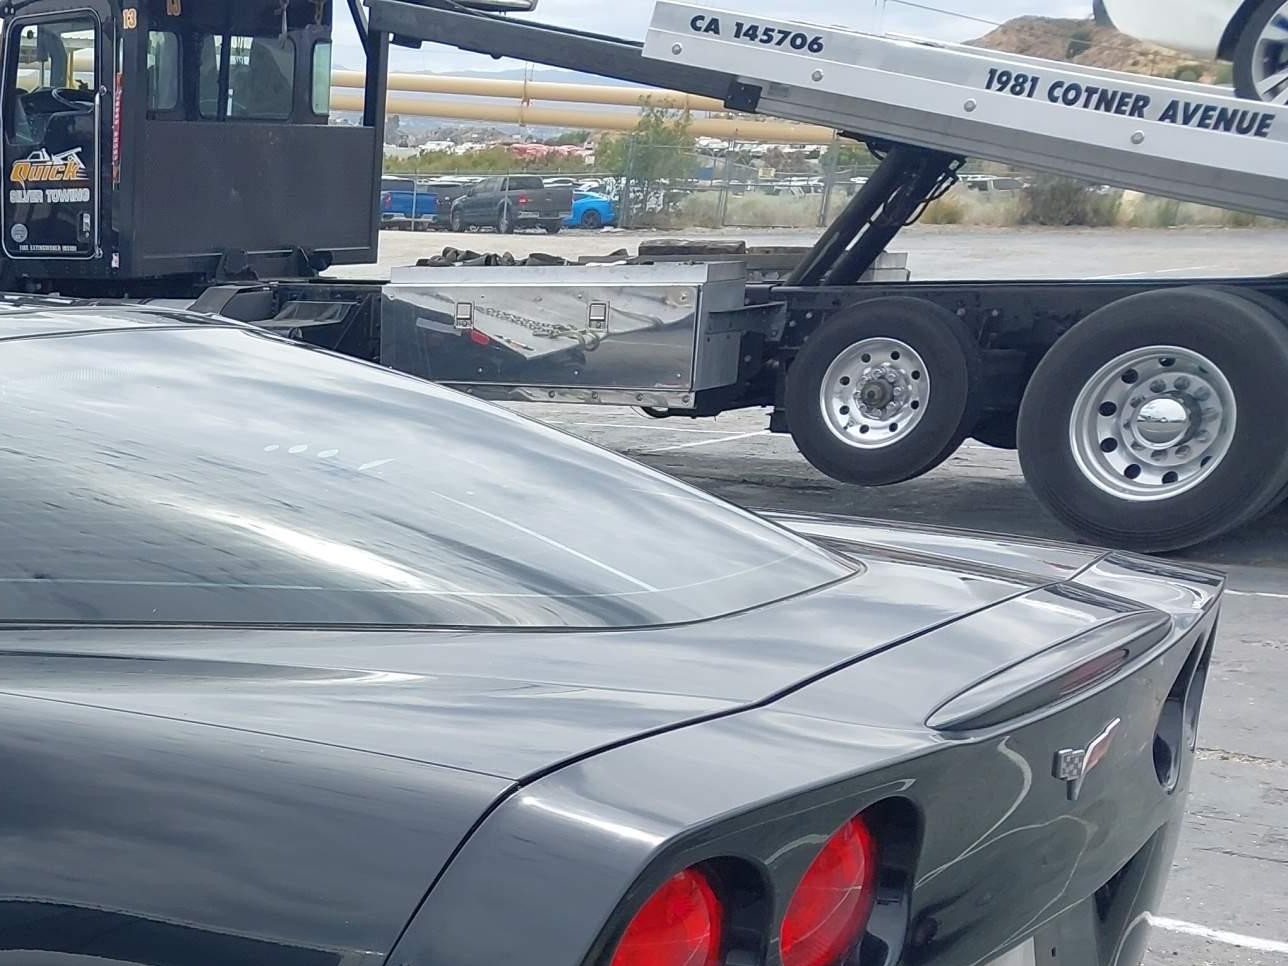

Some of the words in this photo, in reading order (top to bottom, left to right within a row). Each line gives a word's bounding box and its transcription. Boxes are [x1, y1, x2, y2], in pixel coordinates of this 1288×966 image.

[123, 7, 137, 30] 13
[690, 14, 721, 36] CA
[733, 21, 825, 54] 145706
[985, 67, 1040, 99] 1981
[1046, 80, 1152, 119] COTNER
[1158, 99, 1276, 138] AVENUE
[10, 189, 43, 203] SILVER
[45, 188, 90, 203] TOWING
